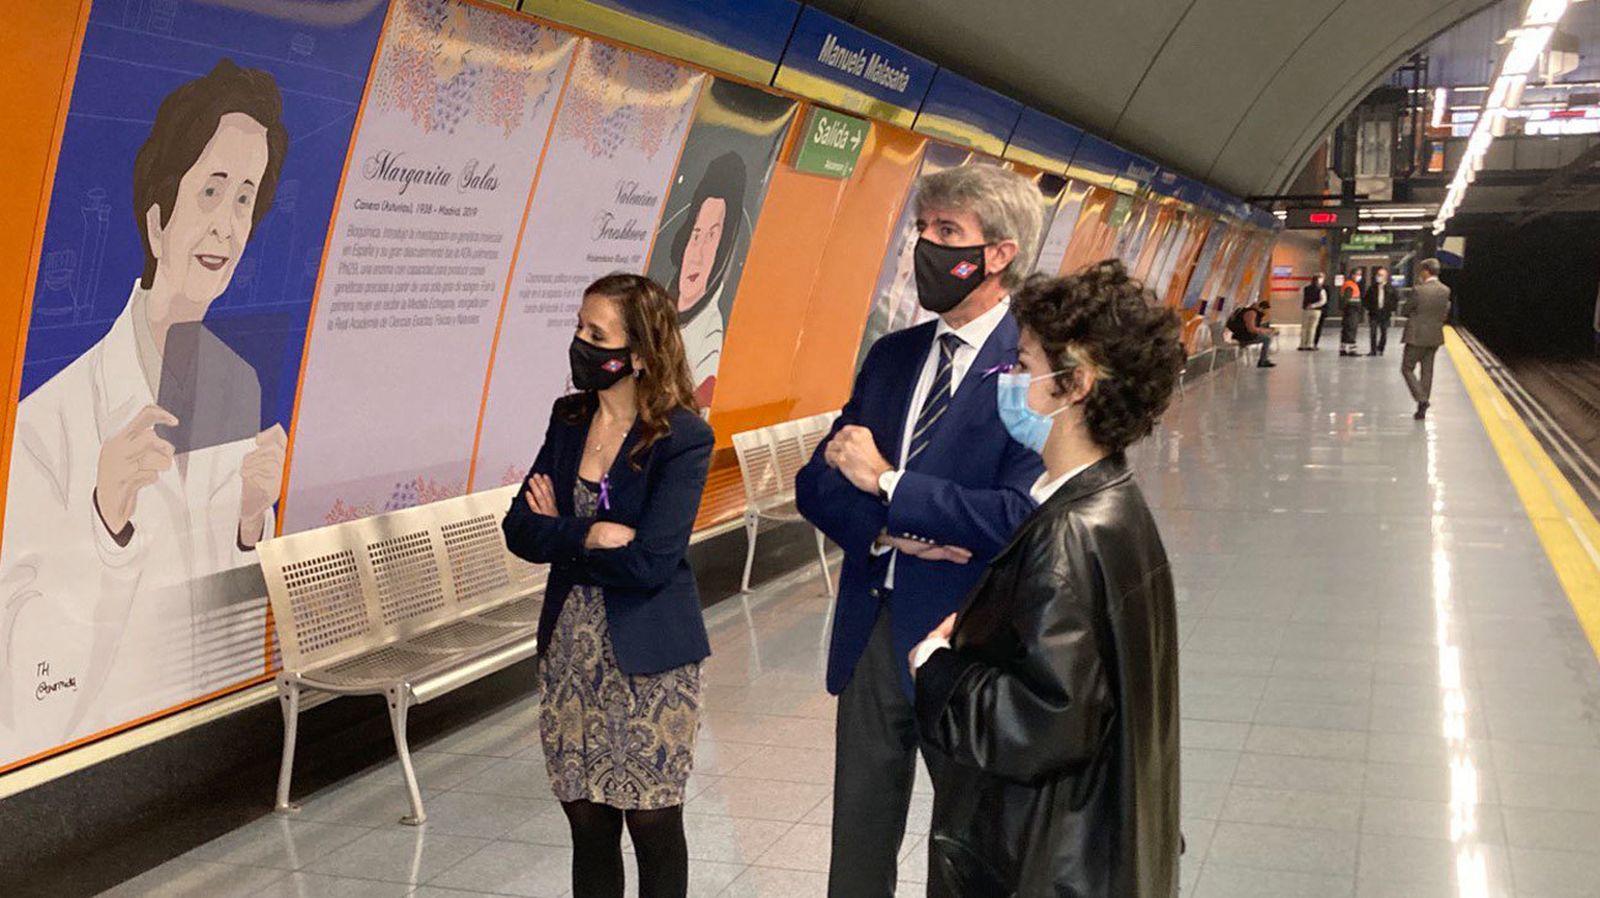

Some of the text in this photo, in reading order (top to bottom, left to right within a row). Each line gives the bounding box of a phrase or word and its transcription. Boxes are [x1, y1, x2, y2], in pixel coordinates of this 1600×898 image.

[818, 33, 910, 93] Manuela Malasaña
[814, 116, 849, 150] Salida
[362, 149, 499, 196] Margarita Salas
